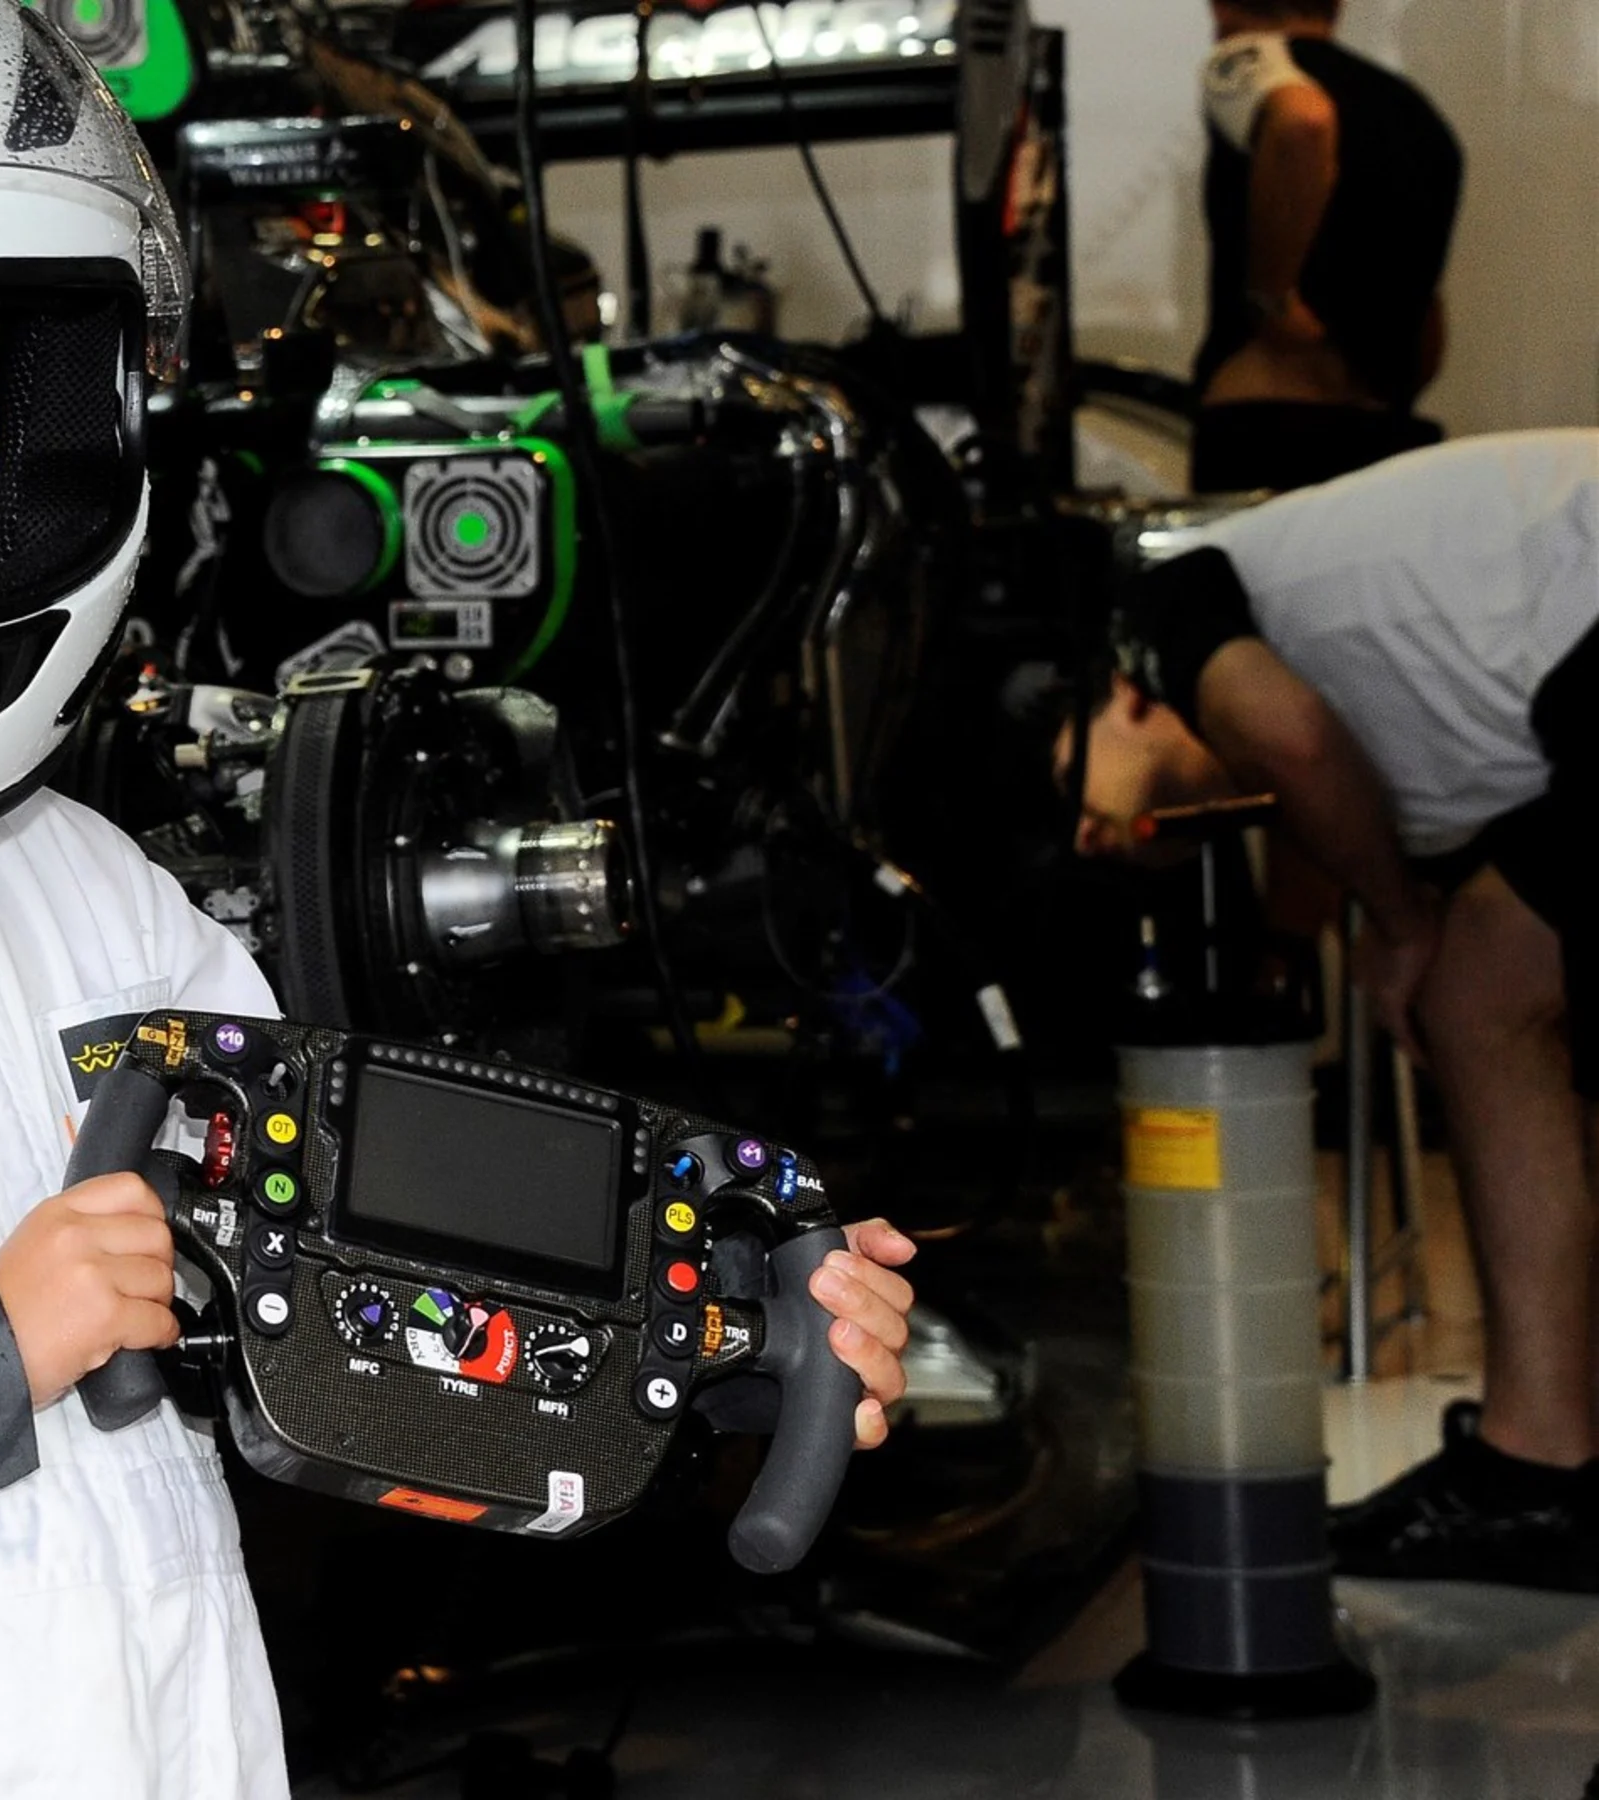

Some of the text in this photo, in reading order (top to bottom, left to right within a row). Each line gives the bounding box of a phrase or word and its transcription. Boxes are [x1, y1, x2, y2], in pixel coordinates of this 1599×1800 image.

[216, 1026, 244, 1046] +10
[272, 1120, 291, 1135] OT
[742, 1145, 761, 1161] +1
[274, 1180, 287, 1194] N
[797, 1174, 825, 1193] BAL
[193, 1207, 219, 1225] ENT
[668, 1208, 693, 1225] PLS
[266, 1231, 285, 1254] X
[672, 1322, 687, 1341] D
[724, 1325, 750, 1343] TRQ
[408, 1329, 426, 1360] DRY
[495, 1329, 516, 1376] PUNCT
[349, 1358, 380, 1375] MFC
[441, 1377, 479, 1397] TYRE
